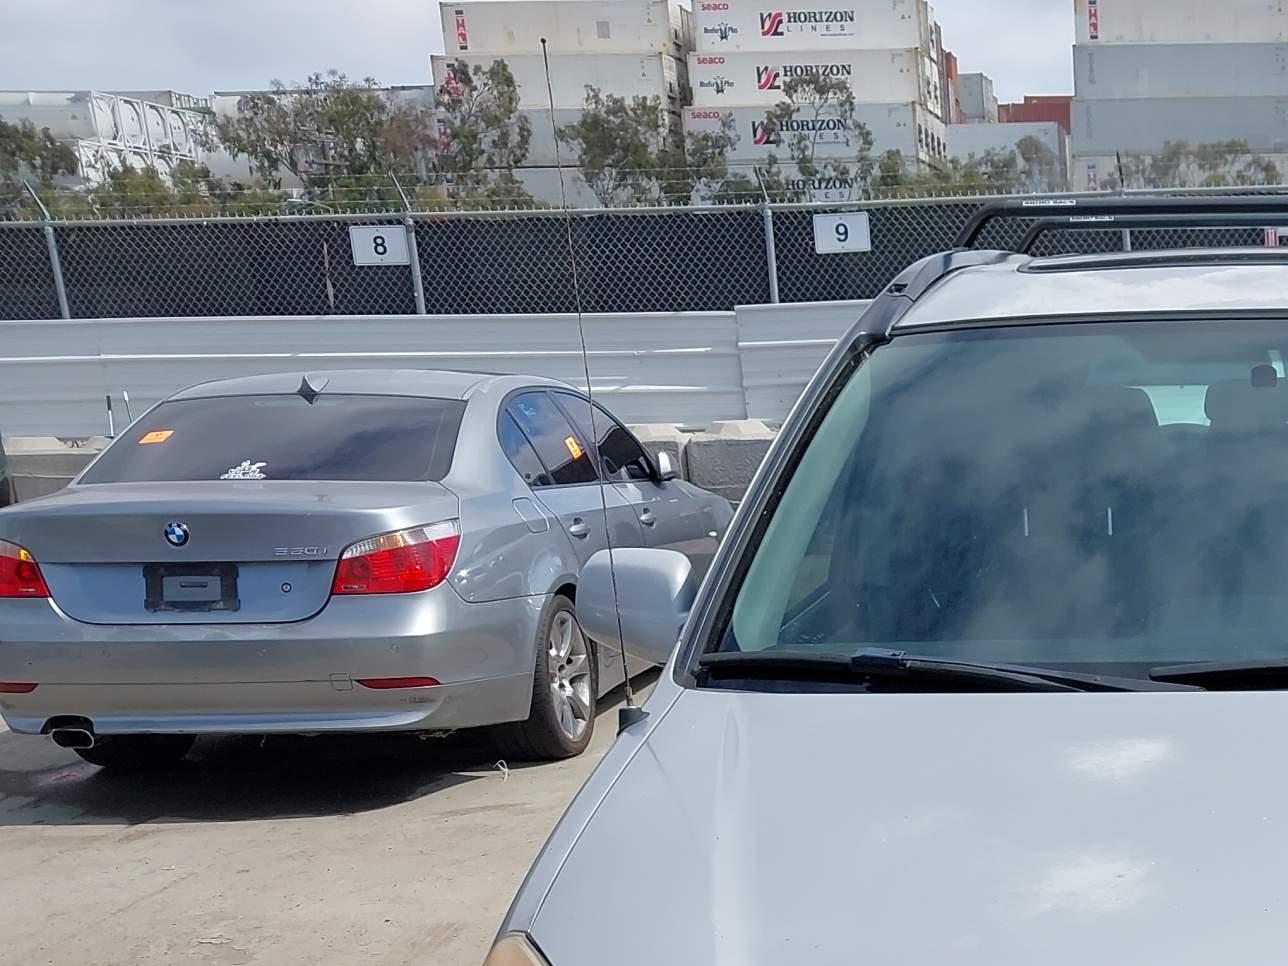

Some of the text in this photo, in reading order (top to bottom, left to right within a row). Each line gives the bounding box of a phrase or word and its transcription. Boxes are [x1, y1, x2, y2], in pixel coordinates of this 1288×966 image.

[701, 2, 728, 11] seaco
[786, 11, 854, 23] HORIZON
[697, 56, 725, 64] seaco
[783, 64, 852, 77] HORIZON
[691, 111, 719, 119] seaco
[780, 119, 847, 131] HORIZON
[835, 223, 848, 242] 9
[373, 235, 387, 255] 8
